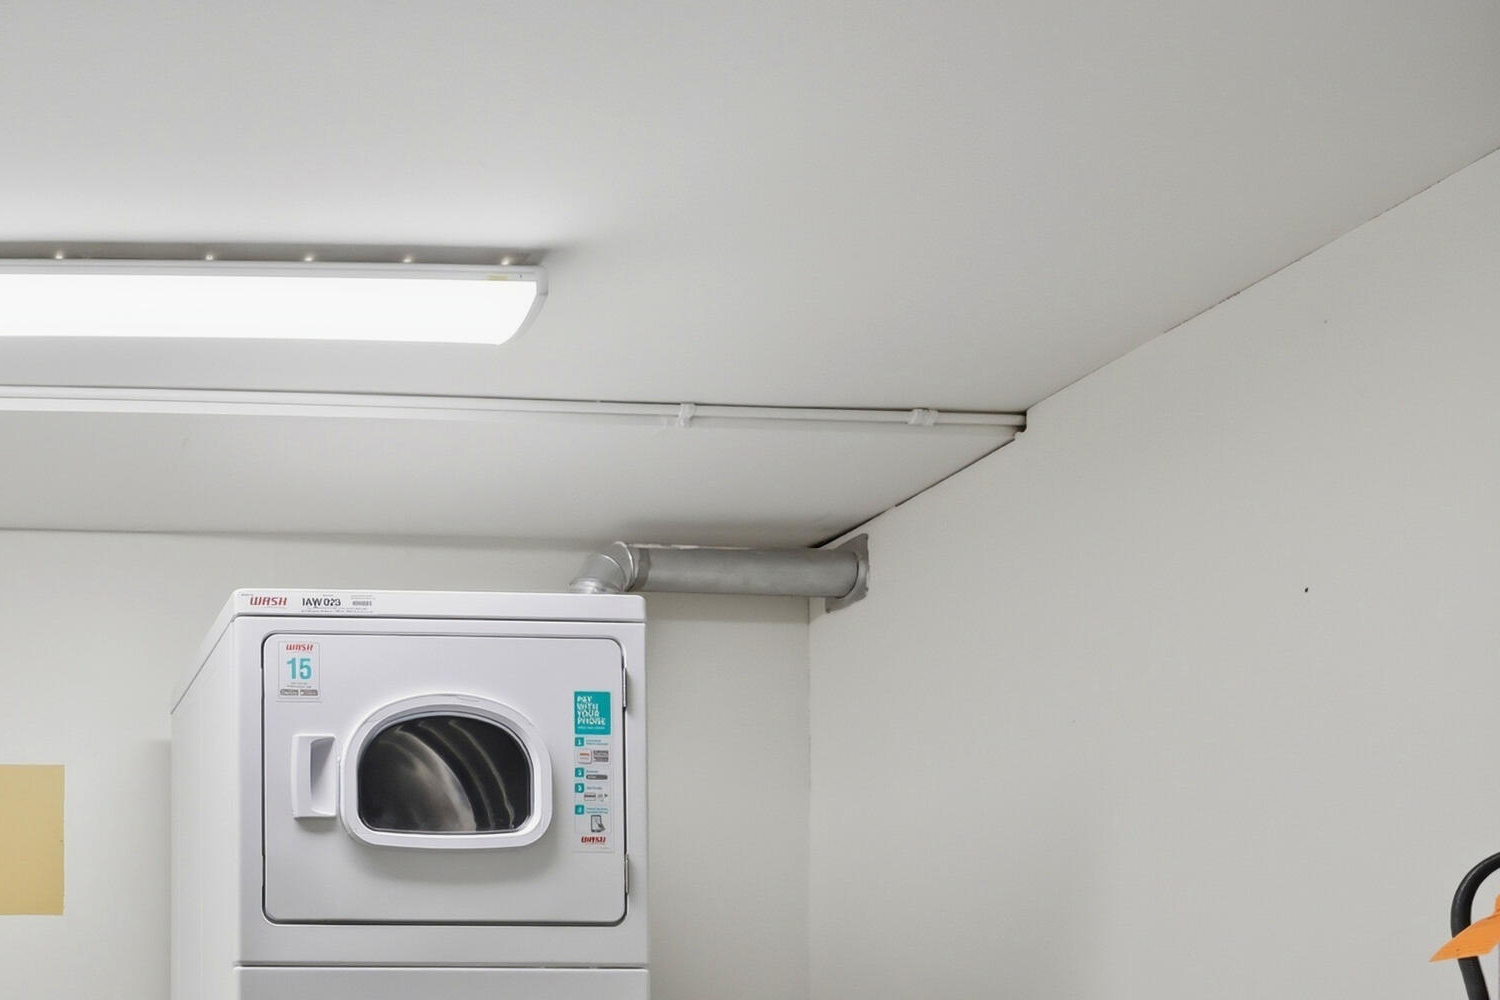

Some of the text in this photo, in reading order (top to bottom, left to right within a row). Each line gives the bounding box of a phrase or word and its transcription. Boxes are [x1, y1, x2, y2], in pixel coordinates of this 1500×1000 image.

[249, 596, 288, 607] WASH
[285, 643, 314, 651] WASH
[286, 656, 312, 680] 15
[577, 695, 593, 703] PAY
[576, 702, 599, 710] WITH
[577, 710, 600, 718] YOUR
[577, 717, 606, 726] PHONE
